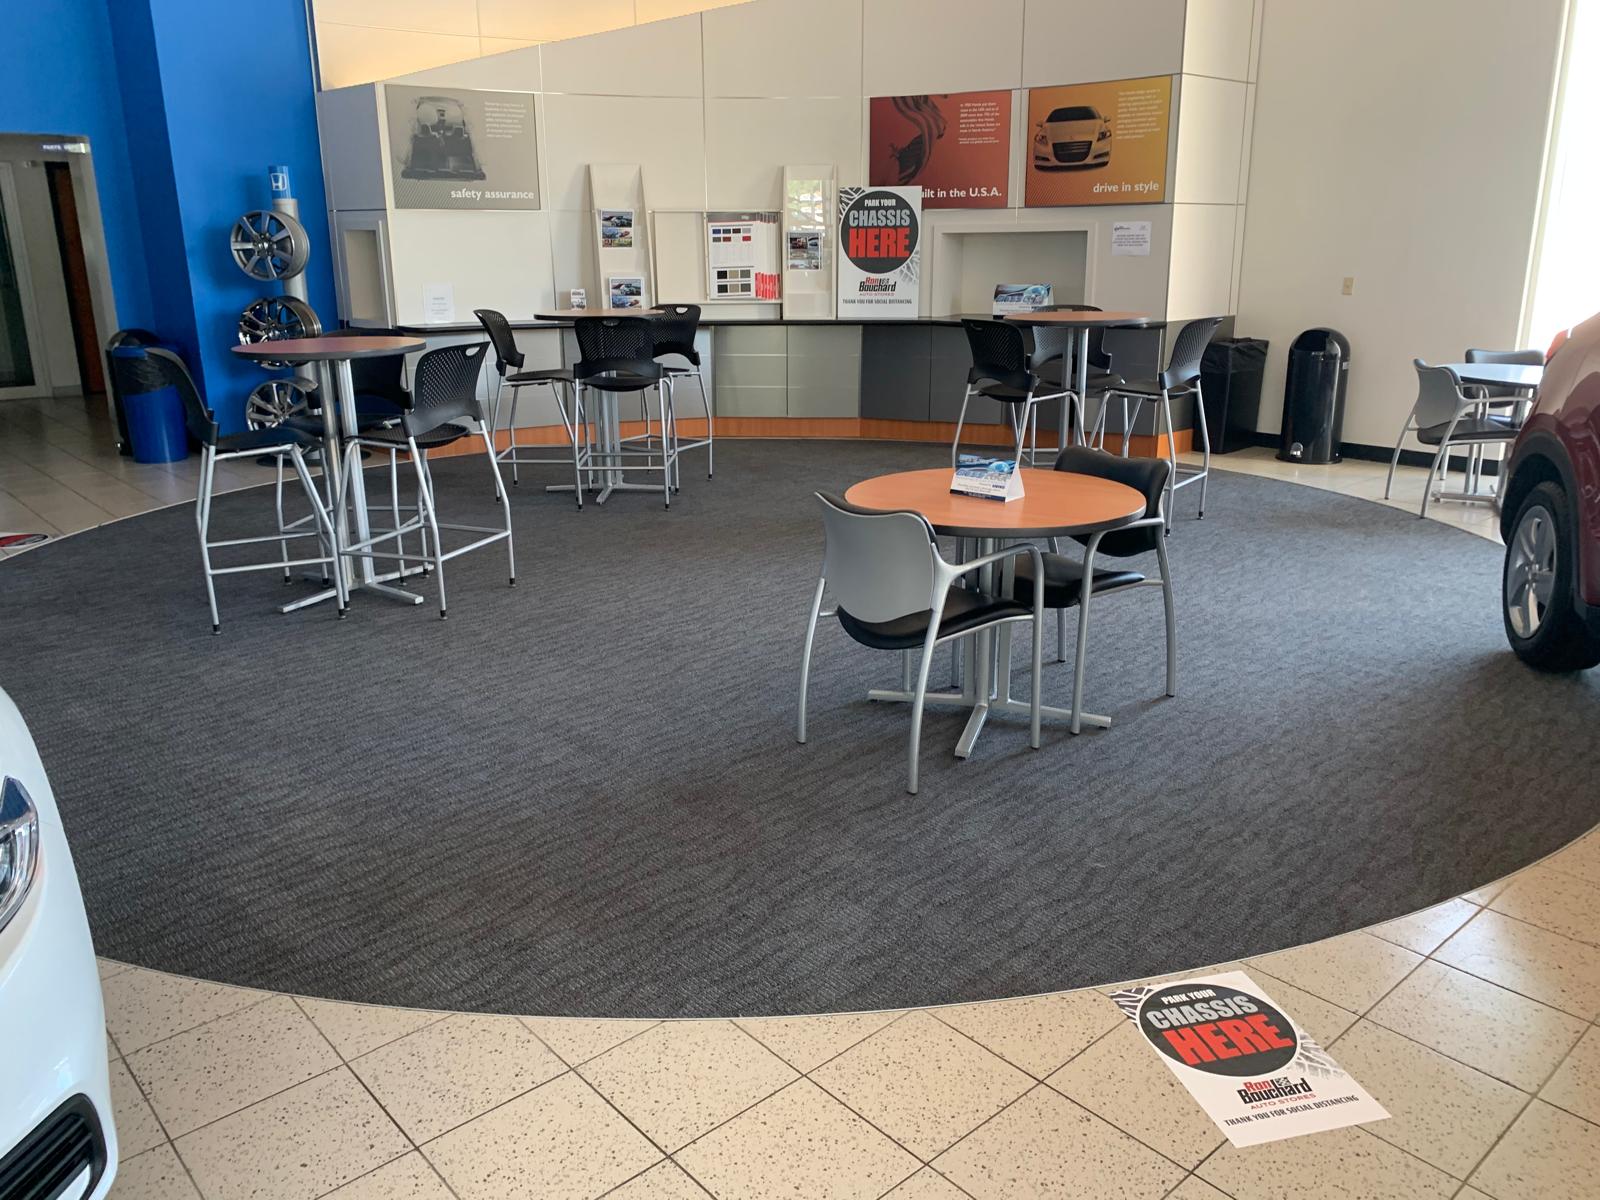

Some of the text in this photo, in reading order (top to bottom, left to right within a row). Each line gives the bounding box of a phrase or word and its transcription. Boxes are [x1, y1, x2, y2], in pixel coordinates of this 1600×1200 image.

[450, 188, 535, 200] safety assurance
[921, 186, 1002, 198] ilt in the U.S.A.
[1093, 181, 1160, 194] drive in style
[864, 199, 880, 207] PARK
[849, 209, 911, 227] CHASSIS
[848, 227, 911, 258] HERE
[858, 279, 897, 292] Bouchard
[865, 276, 879, 284] Ron
[1161, 989, 1216, 1005] PARK YOUR
[1146, 995, 1259, 1029] CHASSIS
[1161, 1013, 1295, 1066] HERE
[1237, 1078, 1313, 1104] Bouchard
[1243, 1080, 1273, 1093] Ron
[1250, 1092, 1317, 1110] AUTO STORES
[1223, 1095, 1360, 1127] THANK YOU FOR SOCIAL DISTANCING
